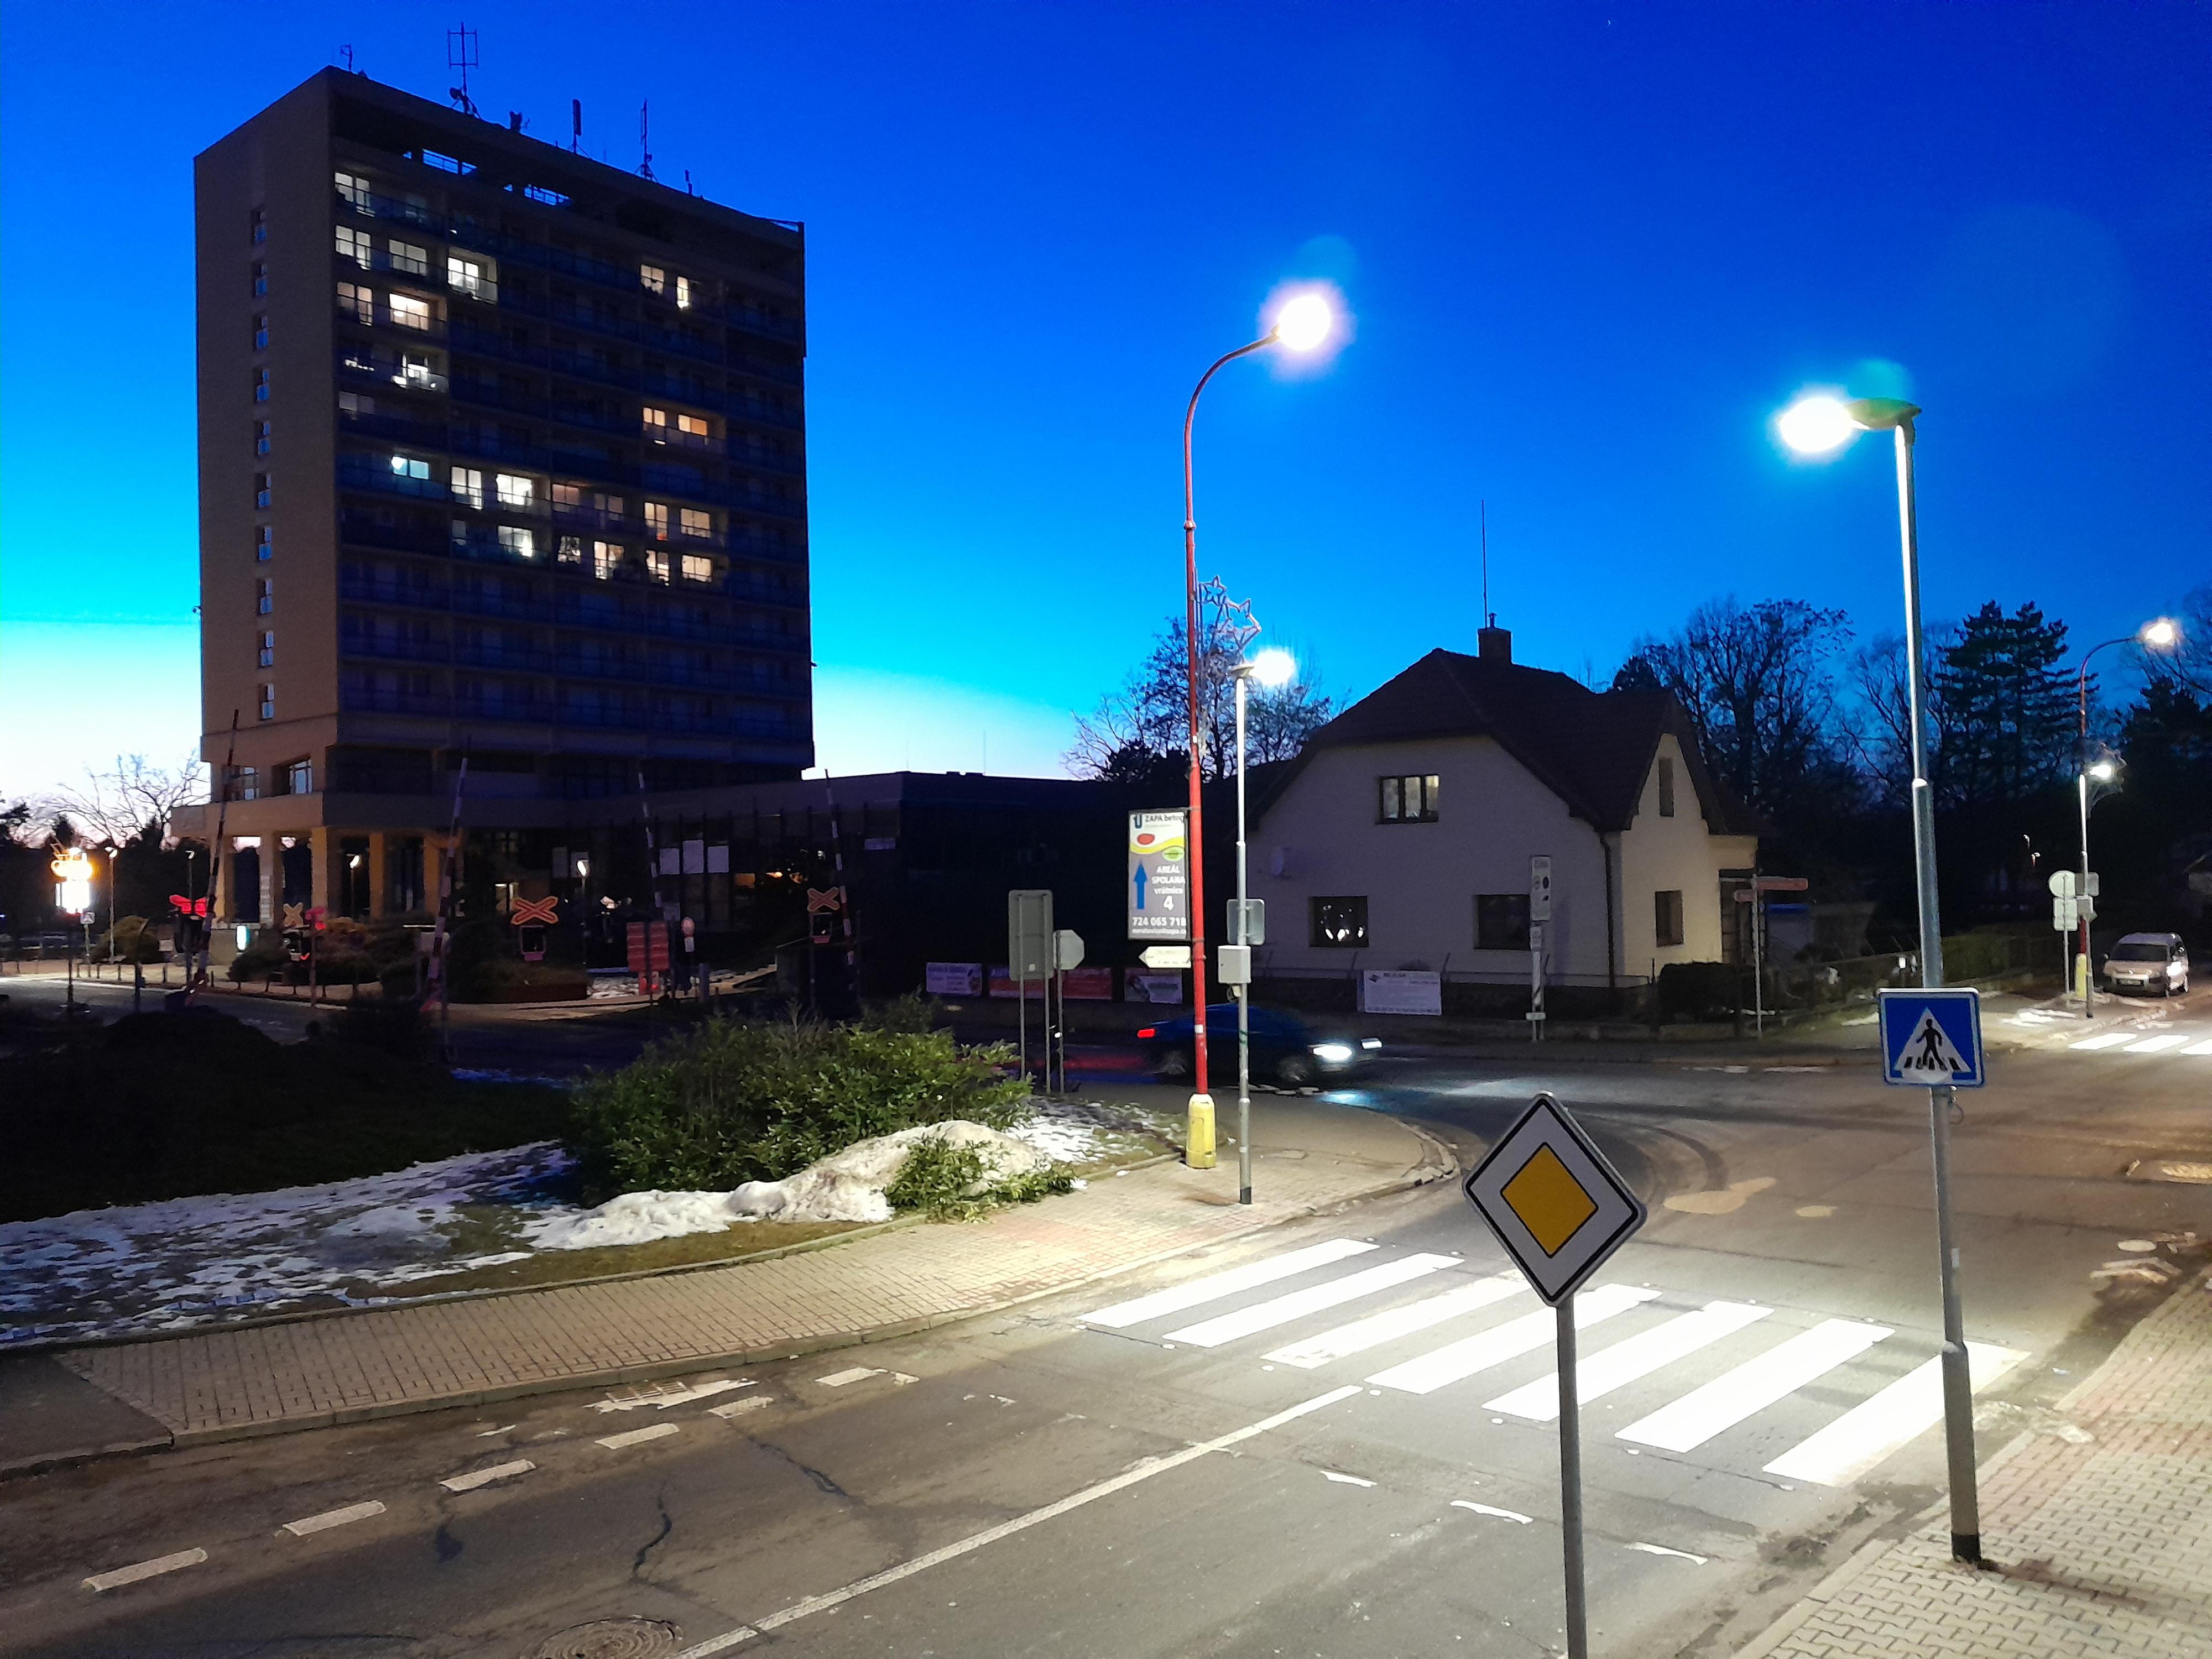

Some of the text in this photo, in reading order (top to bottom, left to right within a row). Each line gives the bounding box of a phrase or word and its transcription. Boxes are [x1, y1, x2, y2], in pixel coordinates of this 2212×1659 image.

[1151, 877, 1186, 885] SPOLANA
[1164, 895, 1174, 911] 4
[1133, 916, 1149, 926] 724
[1169, 916, 1186, 927] 718
